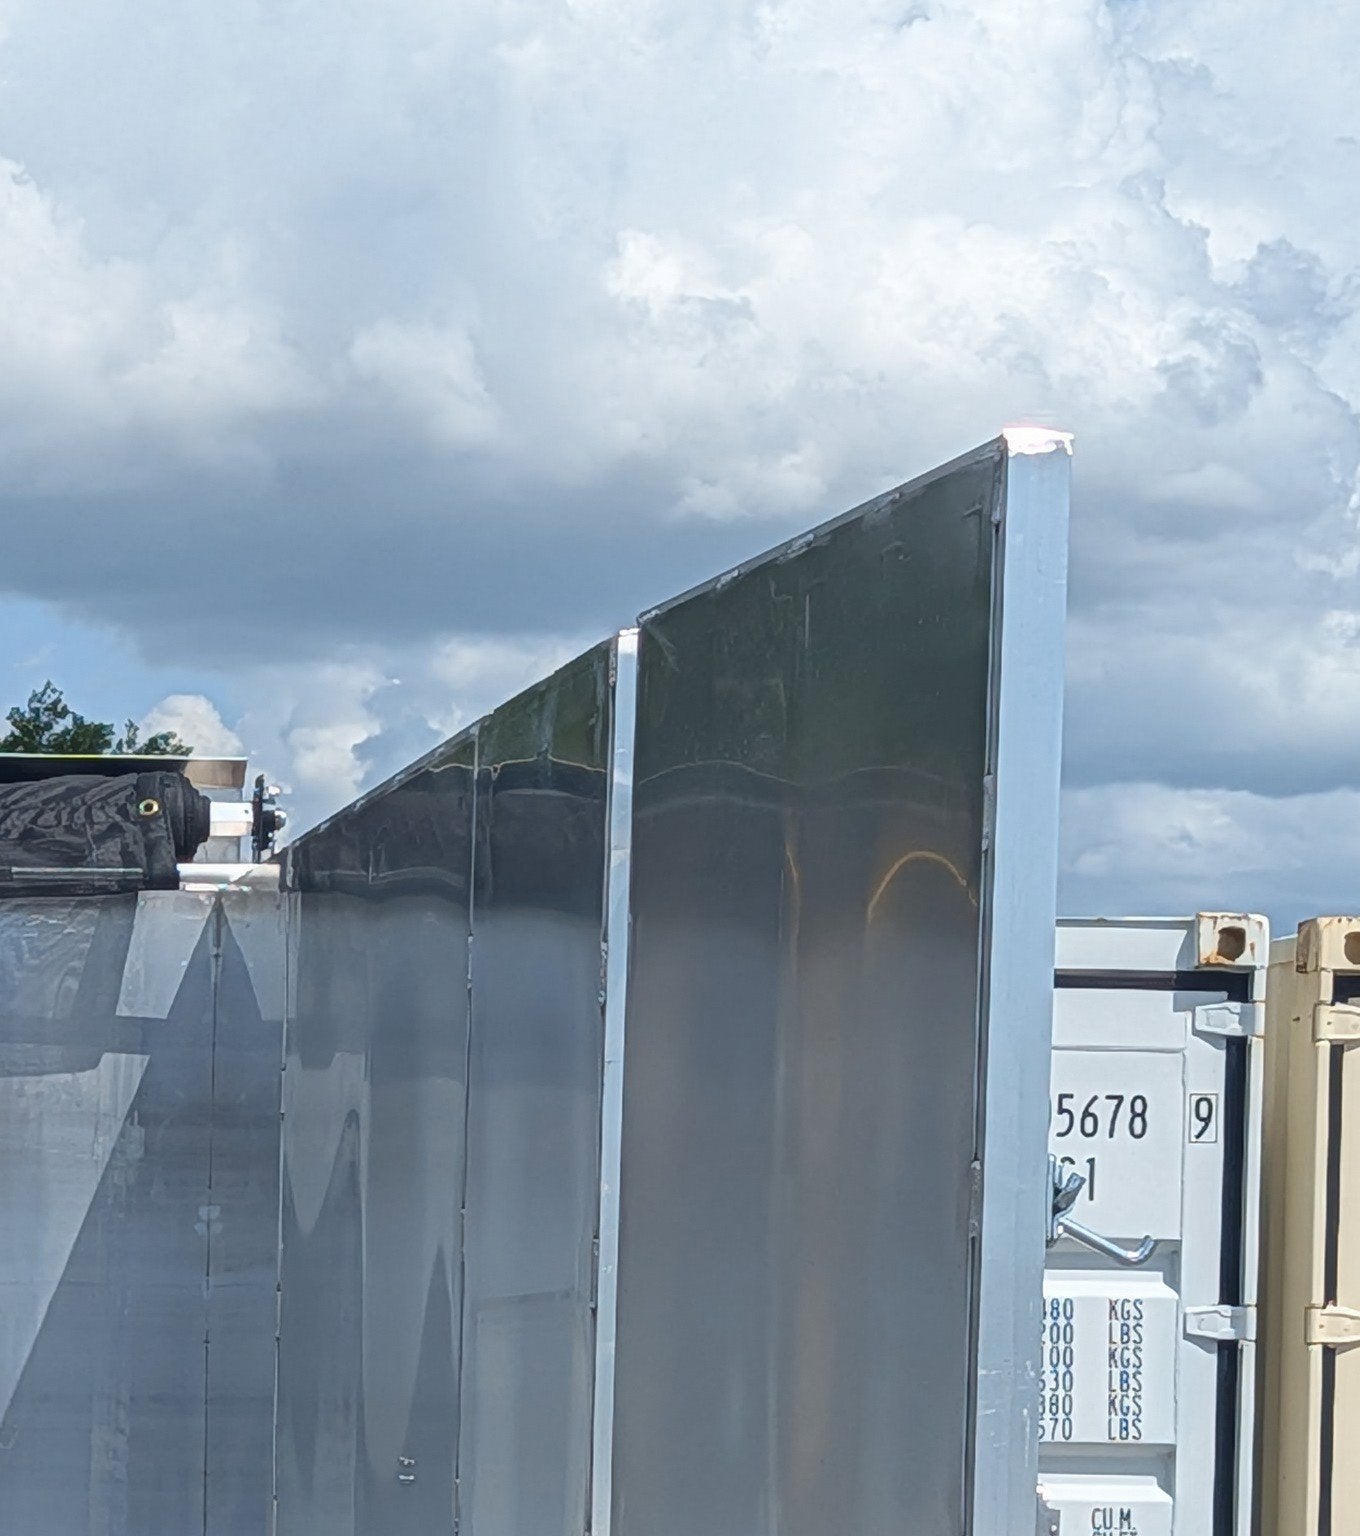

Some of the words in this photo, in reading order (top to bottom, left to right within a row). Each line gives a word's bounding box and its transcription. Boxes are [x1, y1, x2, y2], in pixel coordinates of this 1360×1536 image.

[1056, 1093, 1148, 1139] 5678
[1194, 1097, 1213, 1139] 9
[1108, 1298, 1143, 1321] KGS
[1108, 1322, 1143, 1345] LBS
[1108, 1346, 1143, 1369] KGS
[1107, 1370, 1143, 1392] LBS
[1107, 1393, 1143, 1416] KGS
[1107, 1417, 1143, 1440] LBS
